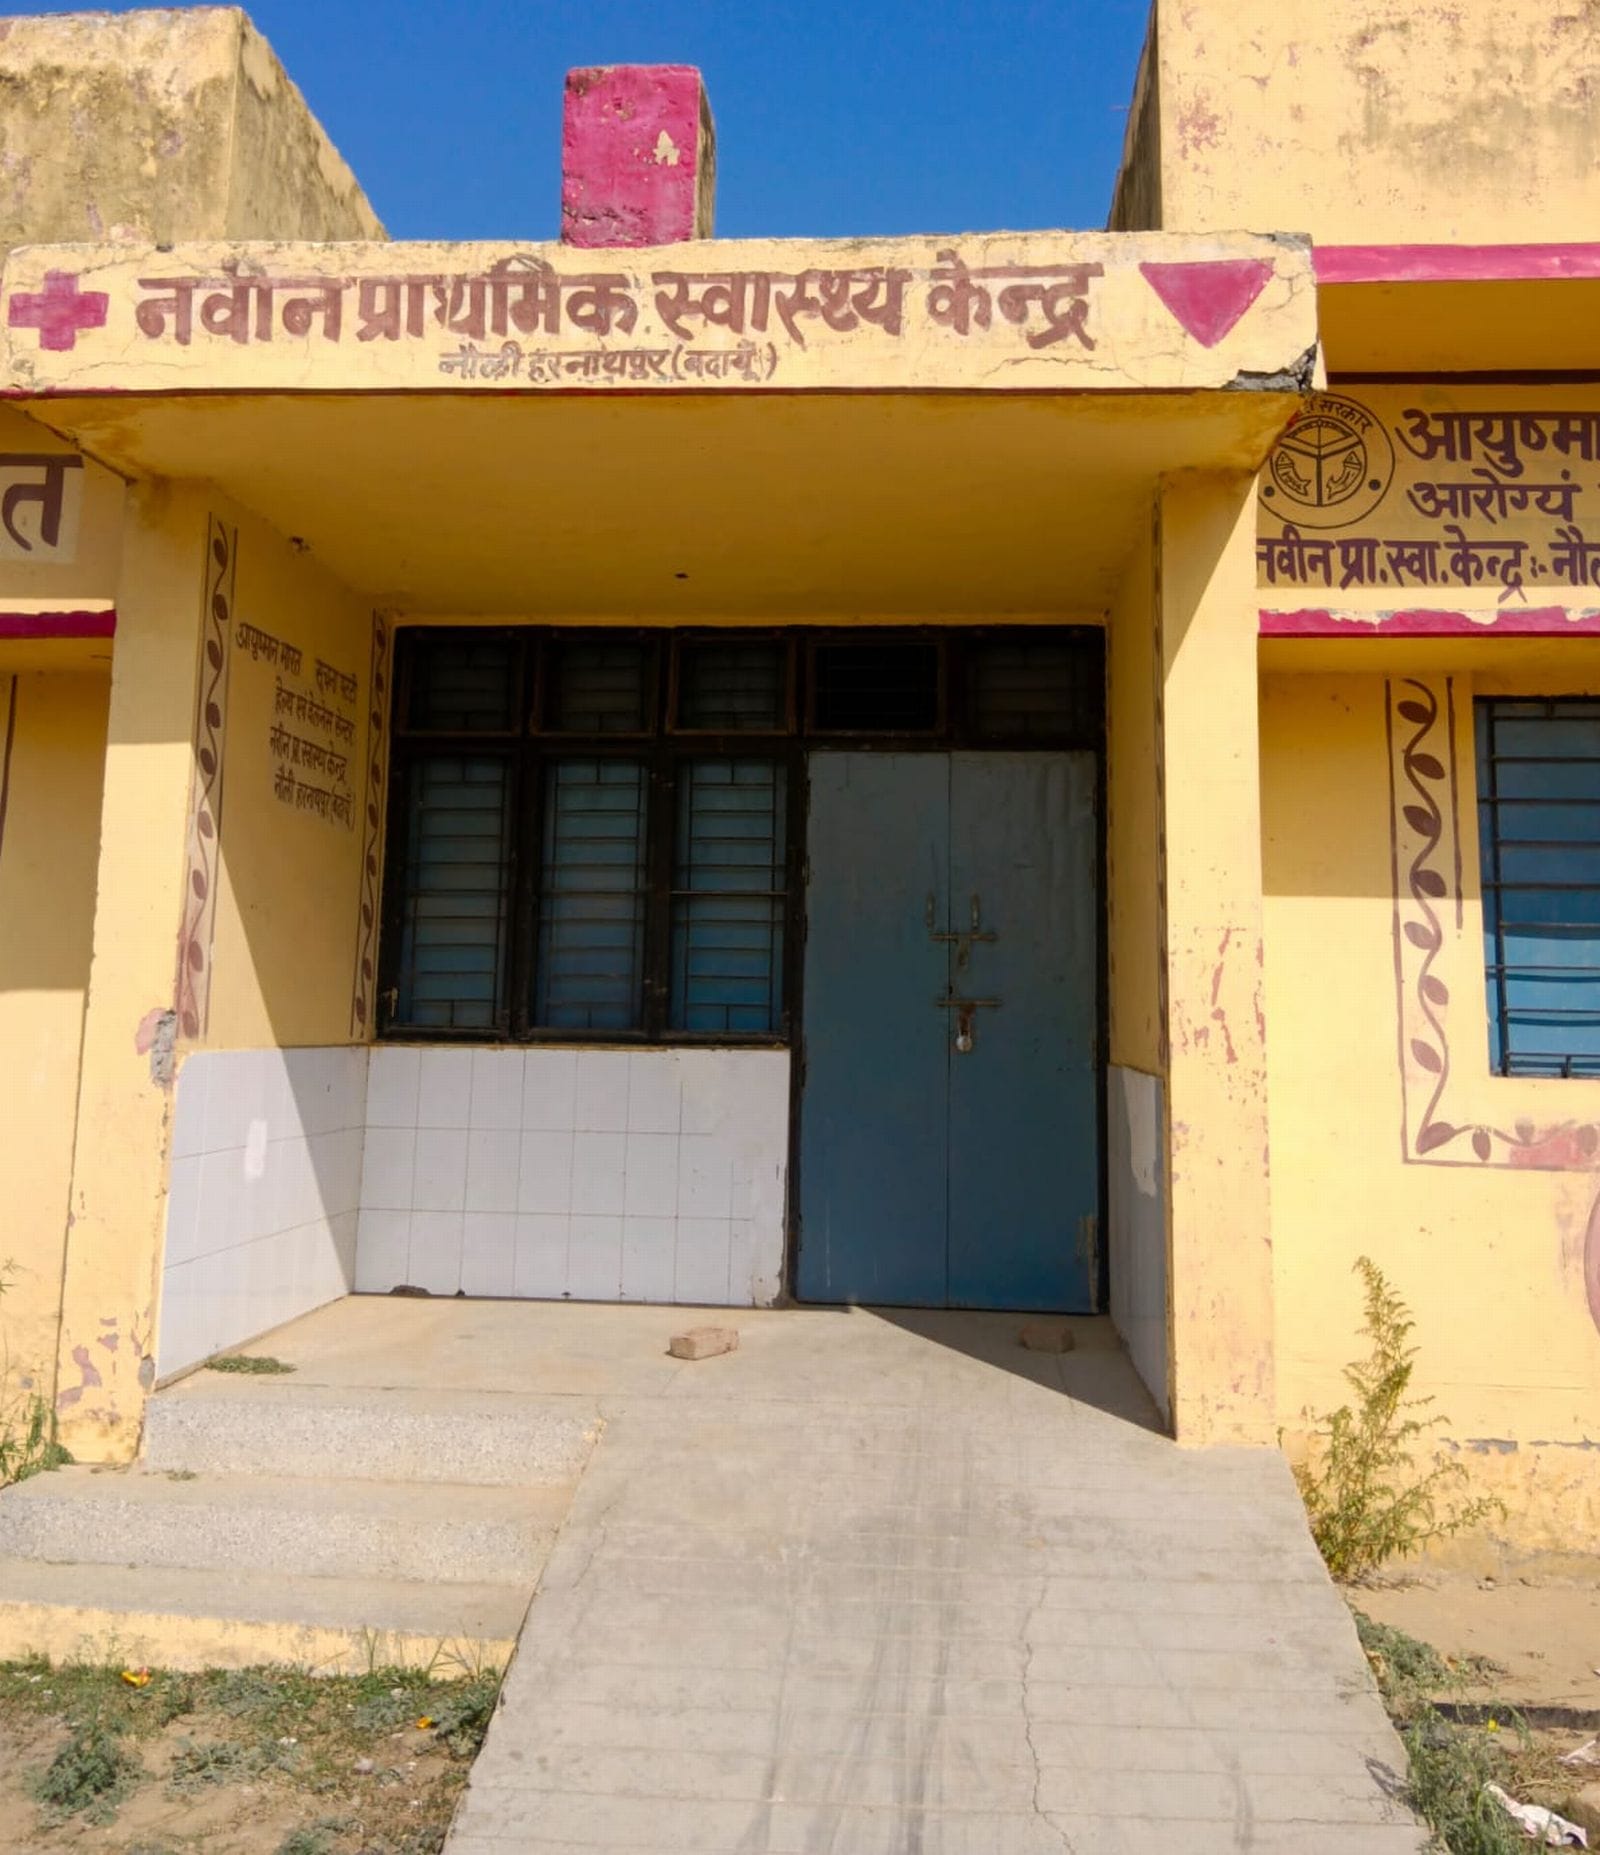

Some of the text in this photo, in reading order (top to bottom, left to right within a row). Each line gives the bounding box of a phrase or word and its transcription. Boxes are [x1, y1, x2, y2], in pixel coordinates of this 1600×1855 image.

[356, 253, 638, 341] प्राथमिक
[652, 267, 912, 351] स्वास्थ्य
[928, 248, 1104, 349] केन्द्र
[1319, 400, 1373, 435] सरकार
[1407, 468, 1583, 525] आरोग्यं
[1256, 524, 1336, 587] नवीन
